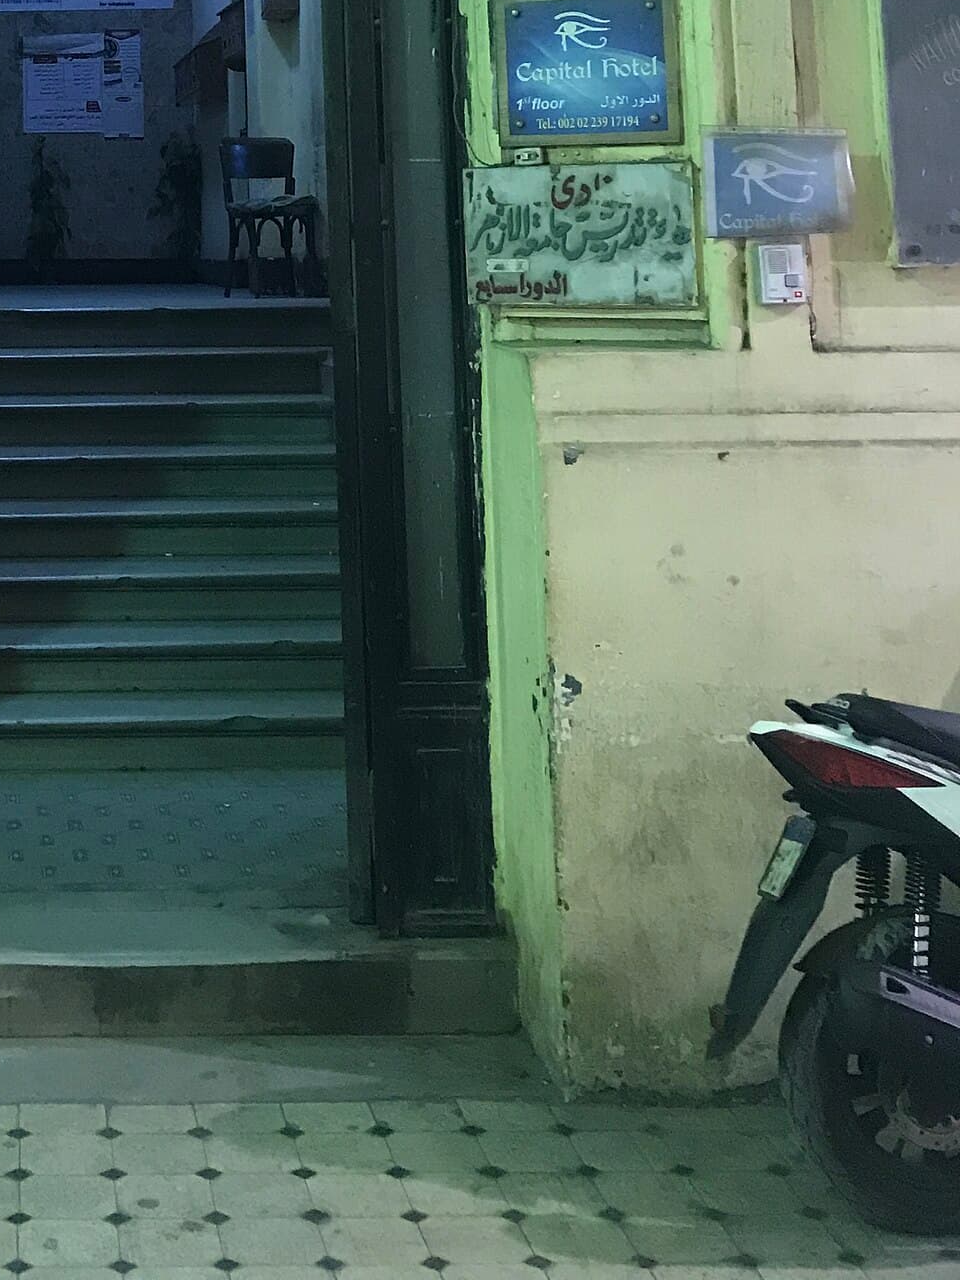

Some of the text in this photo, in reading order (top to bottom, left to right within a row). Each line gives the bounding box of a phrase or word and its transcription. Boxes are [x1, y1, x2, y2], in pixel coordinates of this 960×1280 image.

[516, 60, 592, 85] Capital
[531, 97, 566, 111] floor
[600, 93, 661, 109] الدور الاول
[558, 117, 576, 129] 002
[577, 117, 589, 129] 02
[591, 116, 608, 129] 239
[611, 115, 640, 128] 17194
